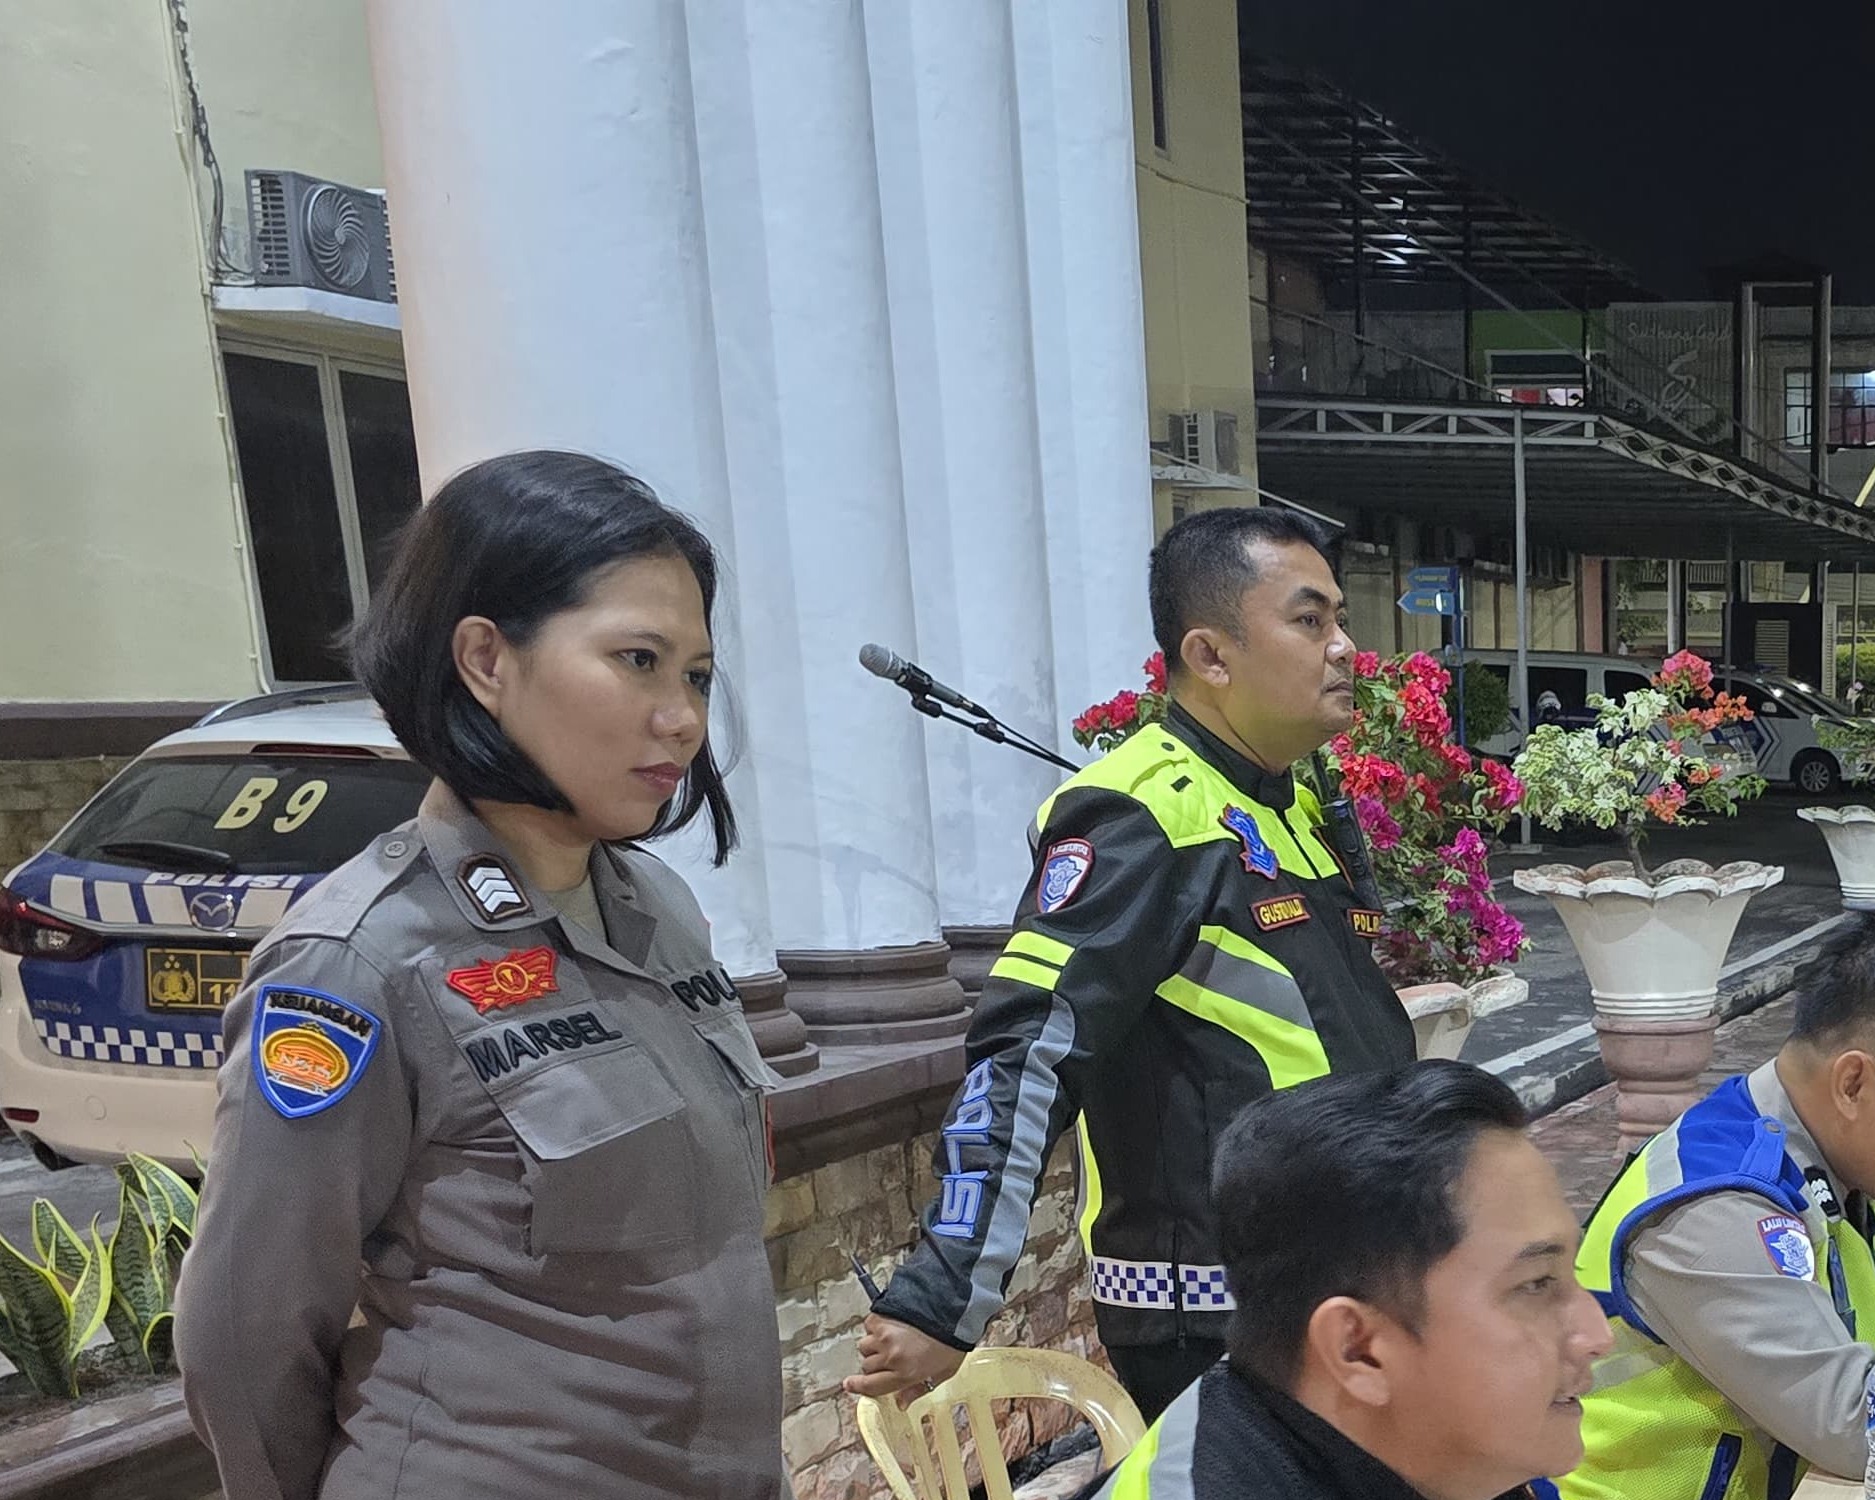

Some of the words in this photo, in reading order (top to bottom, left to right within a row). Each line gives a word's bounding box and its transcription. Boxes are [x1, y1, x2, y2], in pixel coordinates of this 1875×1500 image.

[214, 777, 278, 829] B
[273, 779, 328, 833] 9
[146, 871, 303, 888] POLISI
[466, 1011, 623, 1083] MARSEL
[931, 1057, 994, 1238] POLISI
